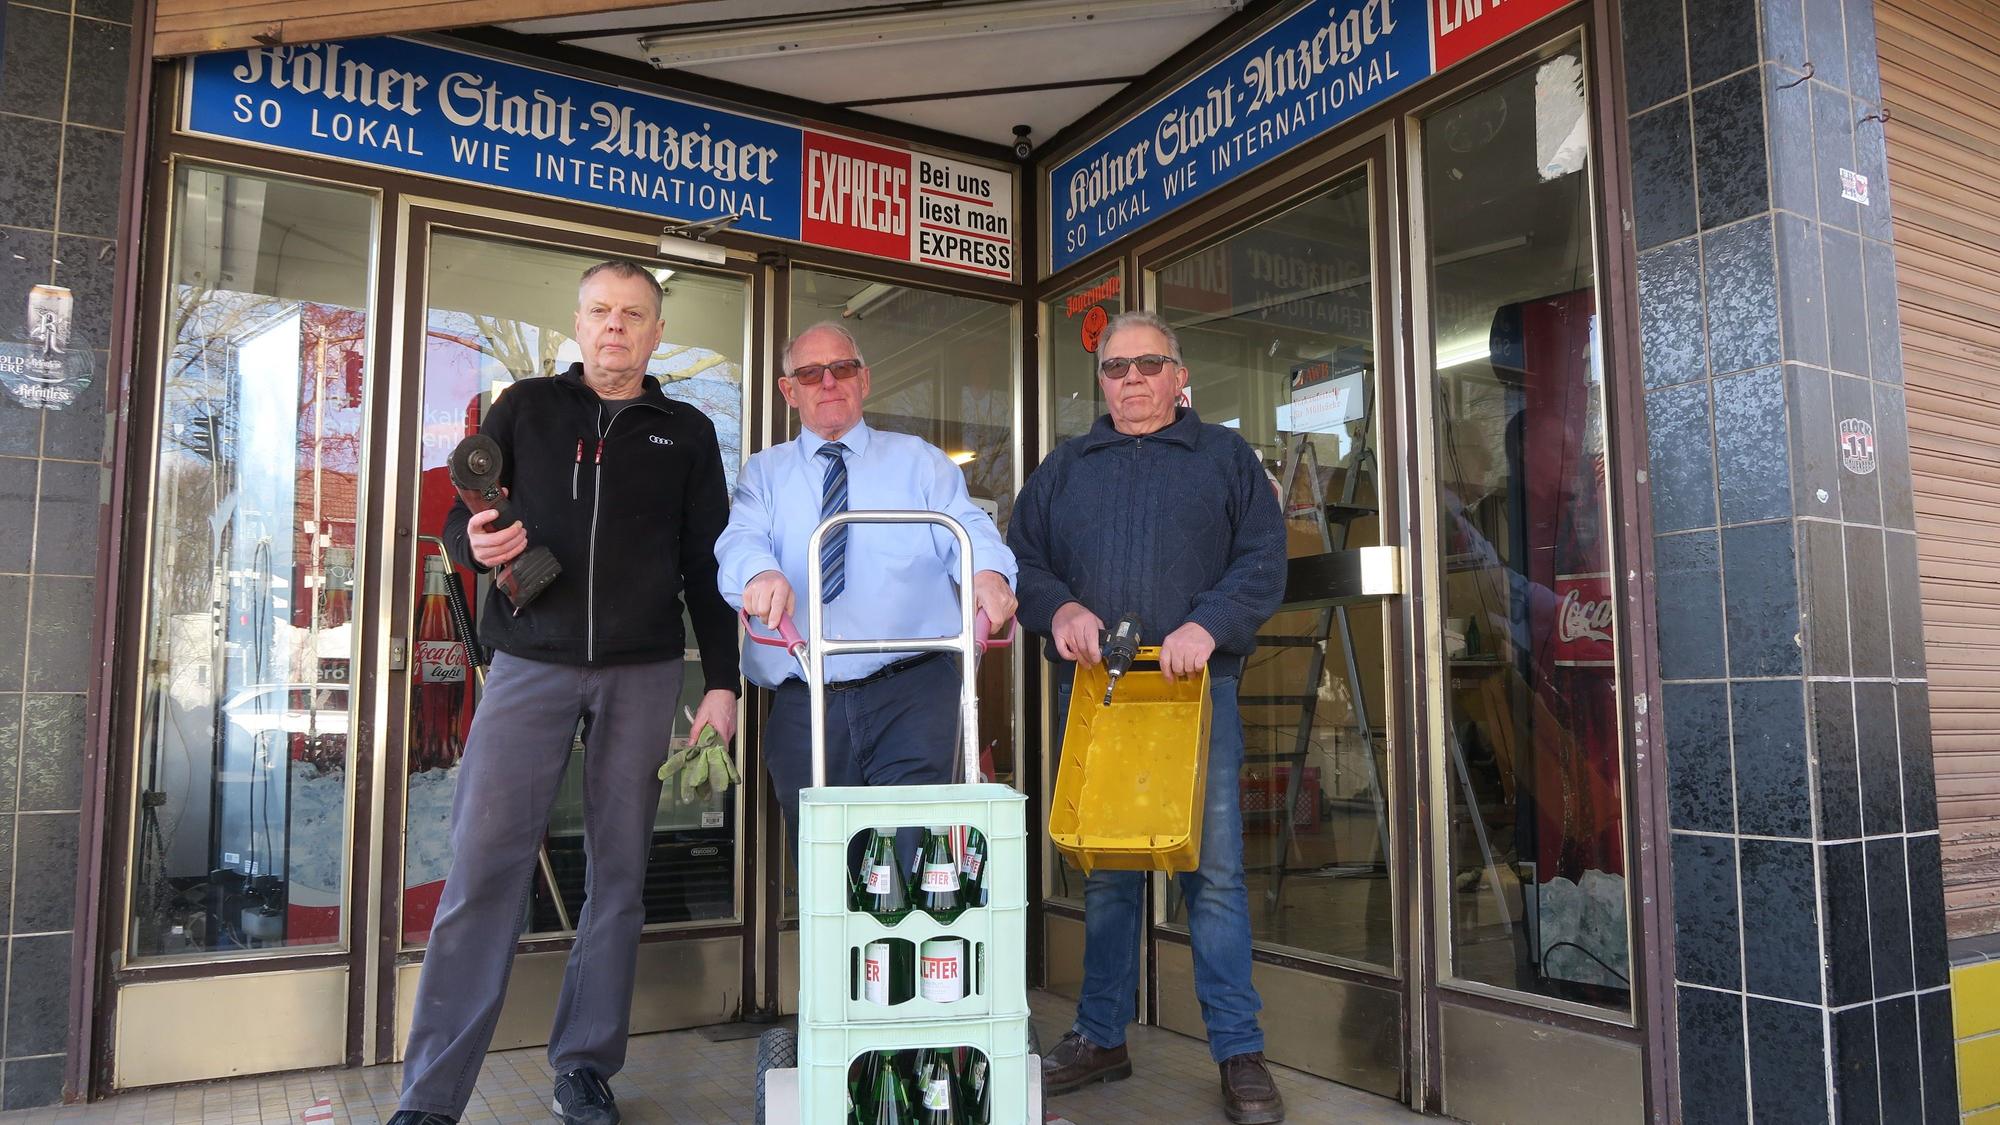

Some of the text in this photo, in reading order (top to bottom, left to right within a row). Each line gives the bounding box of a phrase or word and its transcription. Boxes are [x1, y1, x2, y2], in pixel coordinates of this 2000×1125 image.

[439, 72, 778, 185] Stadt-Anzeiger
[1066, 0, 1398, 221] Kölner Stadt-Anzeiger
[233, 94, 773, 222] SO LOKAL WIE INTERNATIONAL
[919, 161, 991, 198] Bei uns
[1067, 51, 1399, 253] SO LOKAL WIE INTERNATIONAL
[807, 149, 906, 236] EXPRESS
[919, 196, 1008, 235] liest man
[919, 231, 1010, 269] EXPRESS
[1848, 435, 1867, 457] 11
[431, 665, 462, 681] light
